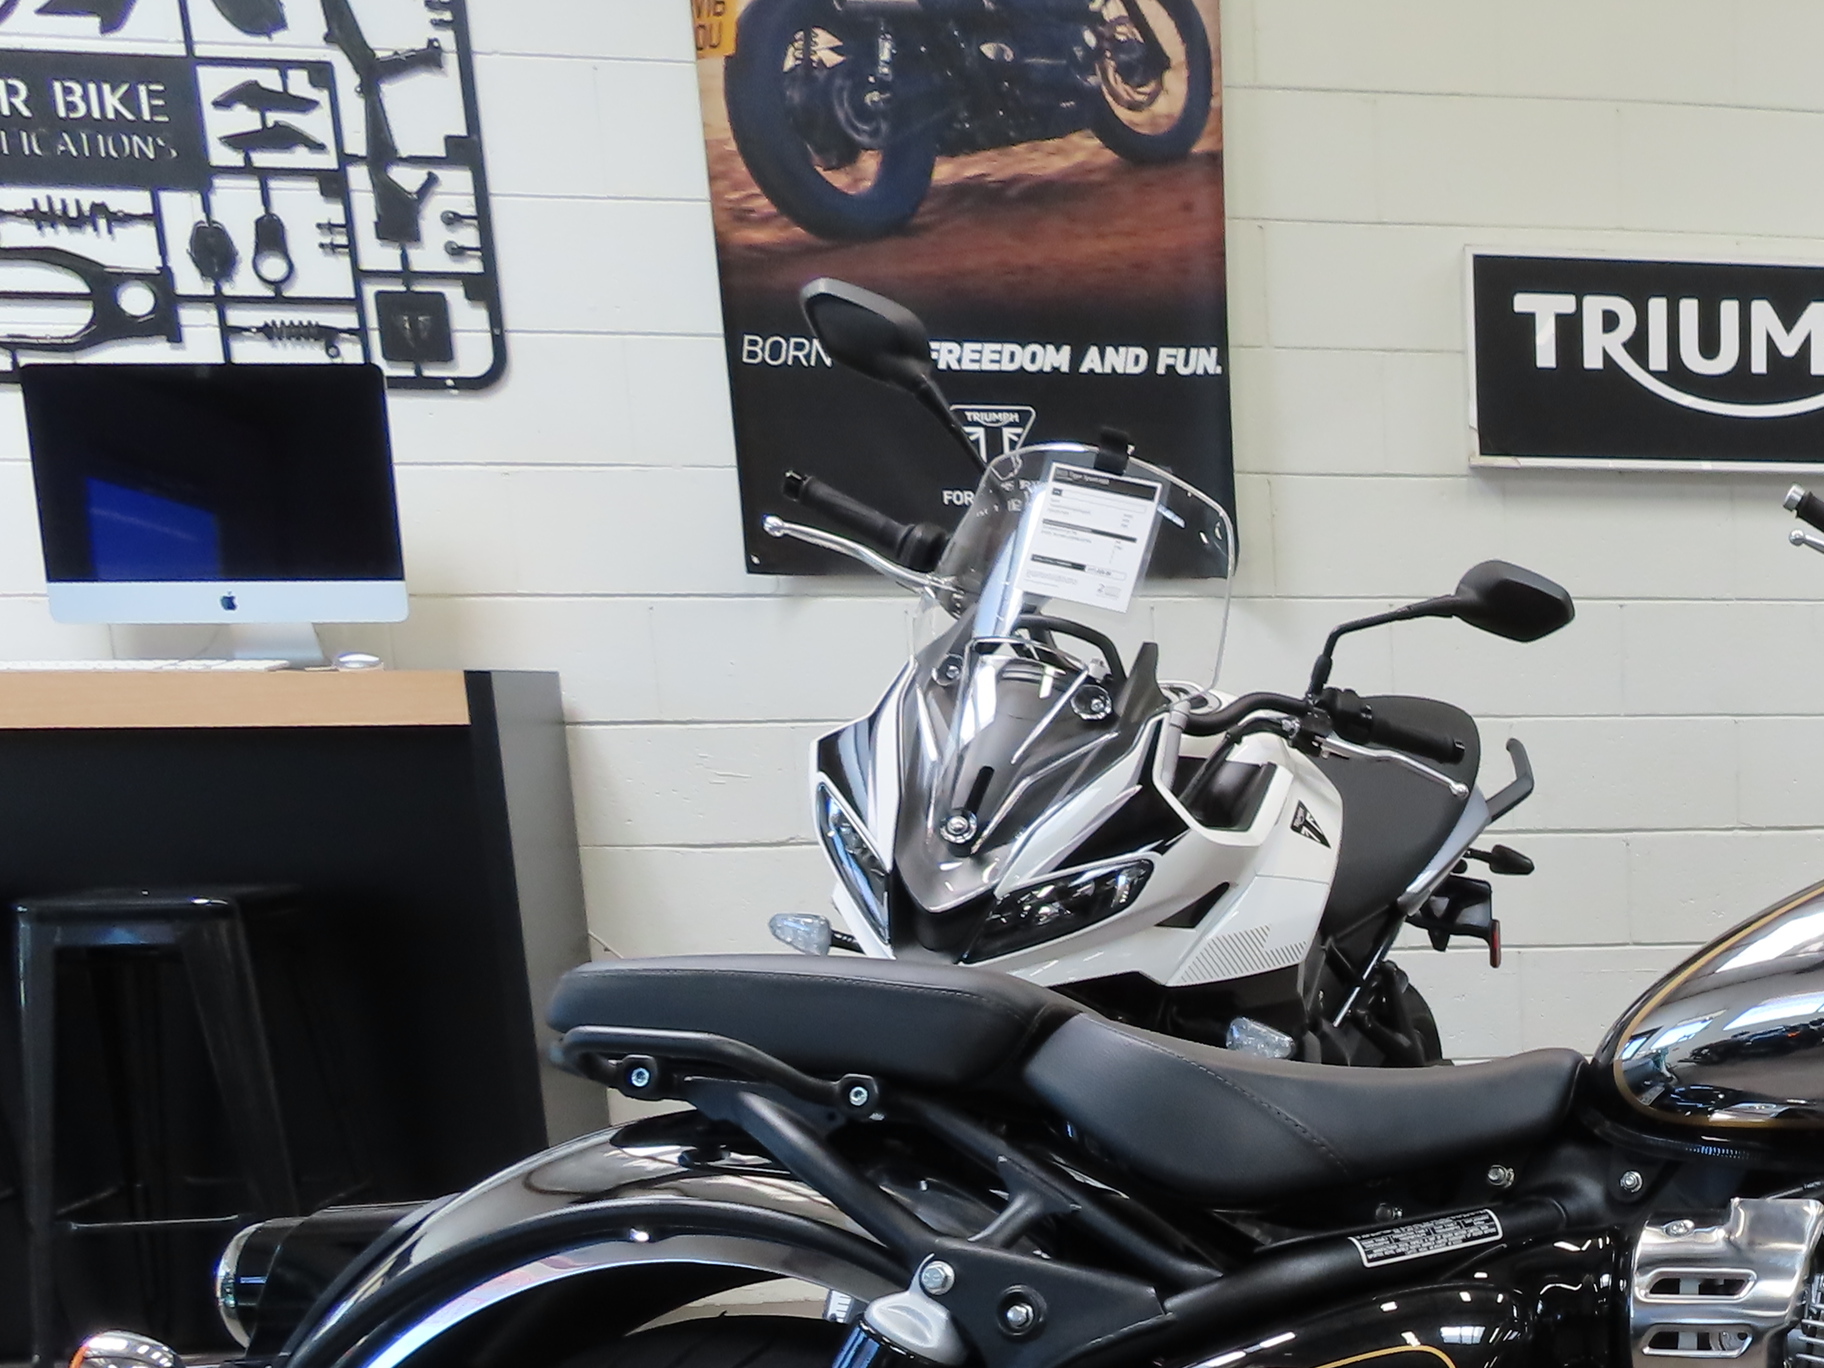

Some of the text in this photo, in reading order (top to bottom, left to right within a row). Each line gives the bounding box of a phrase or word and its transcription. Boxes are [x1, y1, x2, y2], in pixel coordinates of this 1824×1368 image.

[52, 79, 170, 122] BIKE
[741, 333, 1223, 376] BORN FREEDOM AND FUN.
[964, 411, 1020, 427] TRIUMPH
[942, 490, 976, 506] FOR
